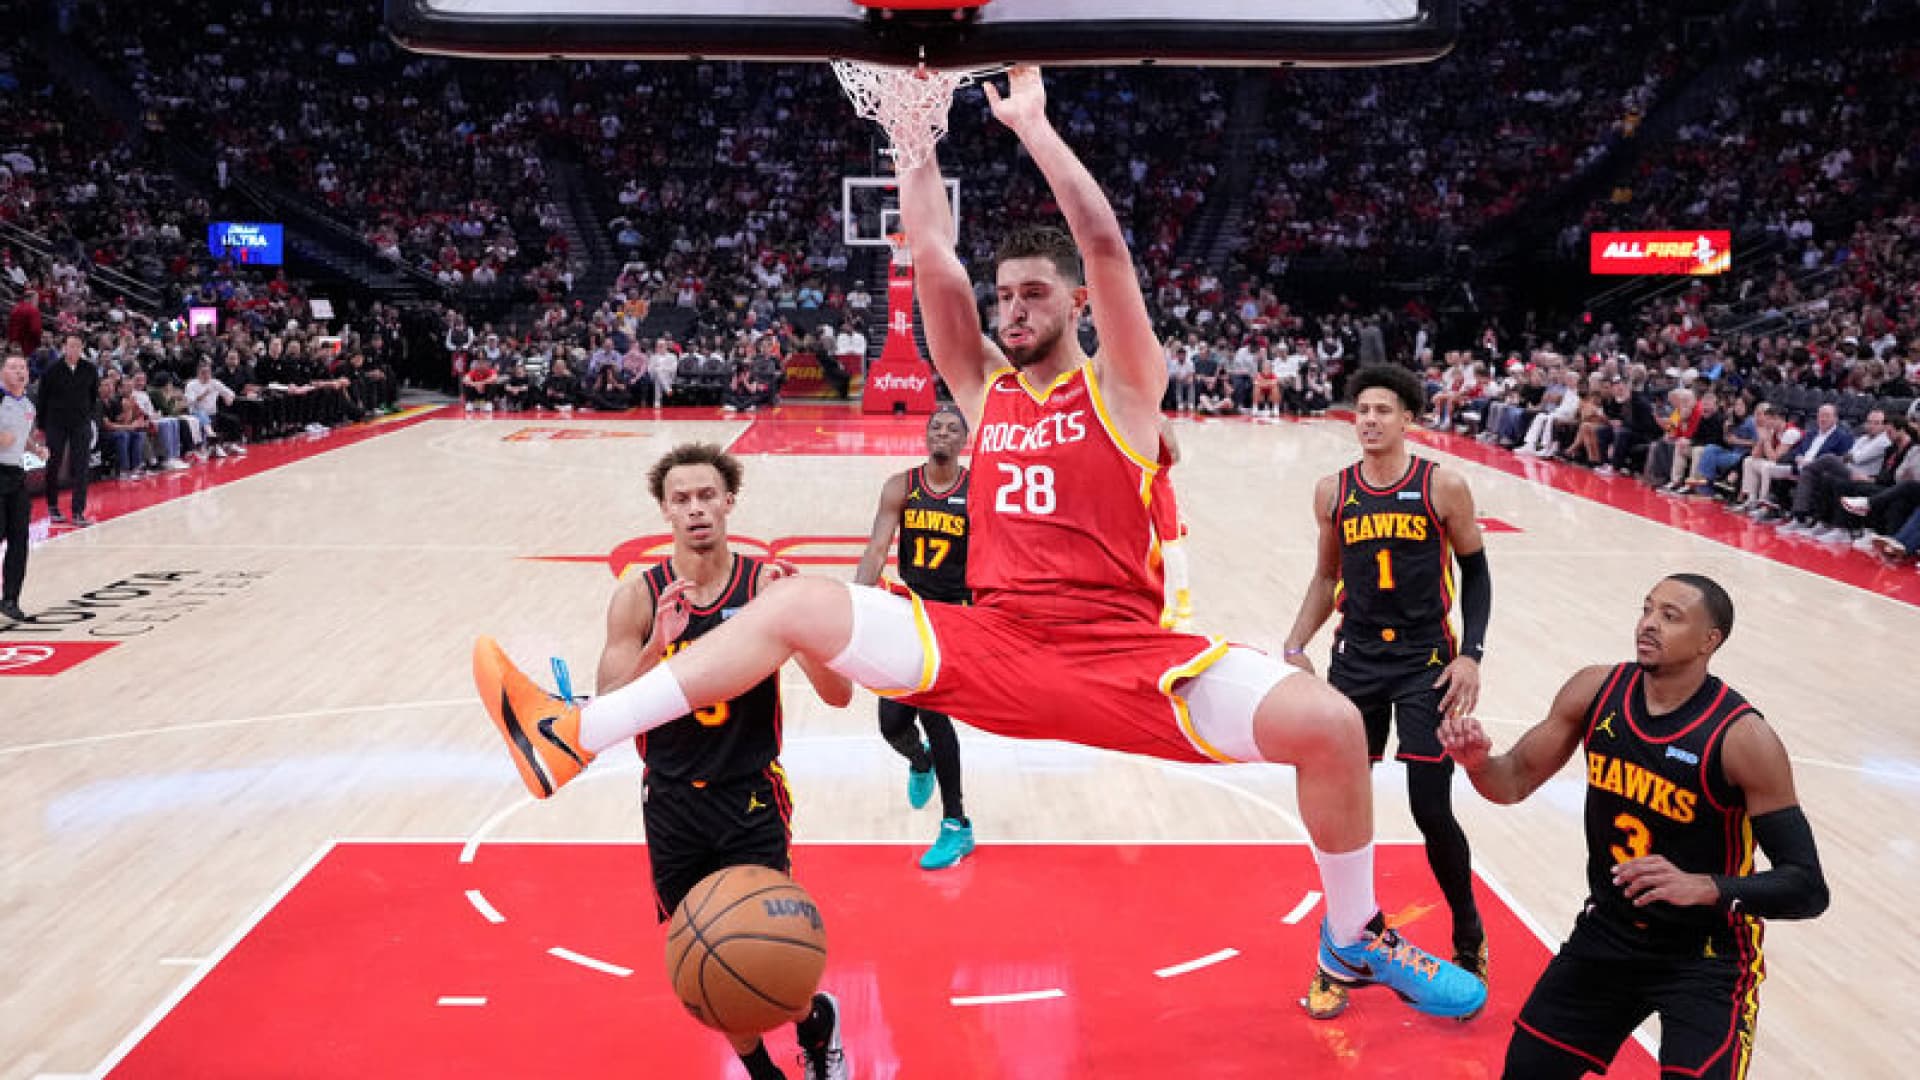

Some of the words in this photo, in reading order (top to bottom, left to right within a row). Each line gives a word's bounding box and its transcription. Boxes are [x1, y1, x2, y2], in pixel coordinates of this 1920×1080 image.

[1602, 241, 1643, 257] ALL
[1645, 241, 1695, 257] FIRE
[873, 372, 927, 391] xfinity
[982, 410, 1086, 453] ROCKETS
[995, 462, 1056, 514] 28
[904, 509, 966, 536] HAWKS
[1343, 513, 1427, 545] HAWKS
[912, 536, 951, 569] 17
[1376, 549, 1395, 590] 1
[1588, 751, 1698, 823] HAWKS
[1610, 813, 1652, 864] 3
